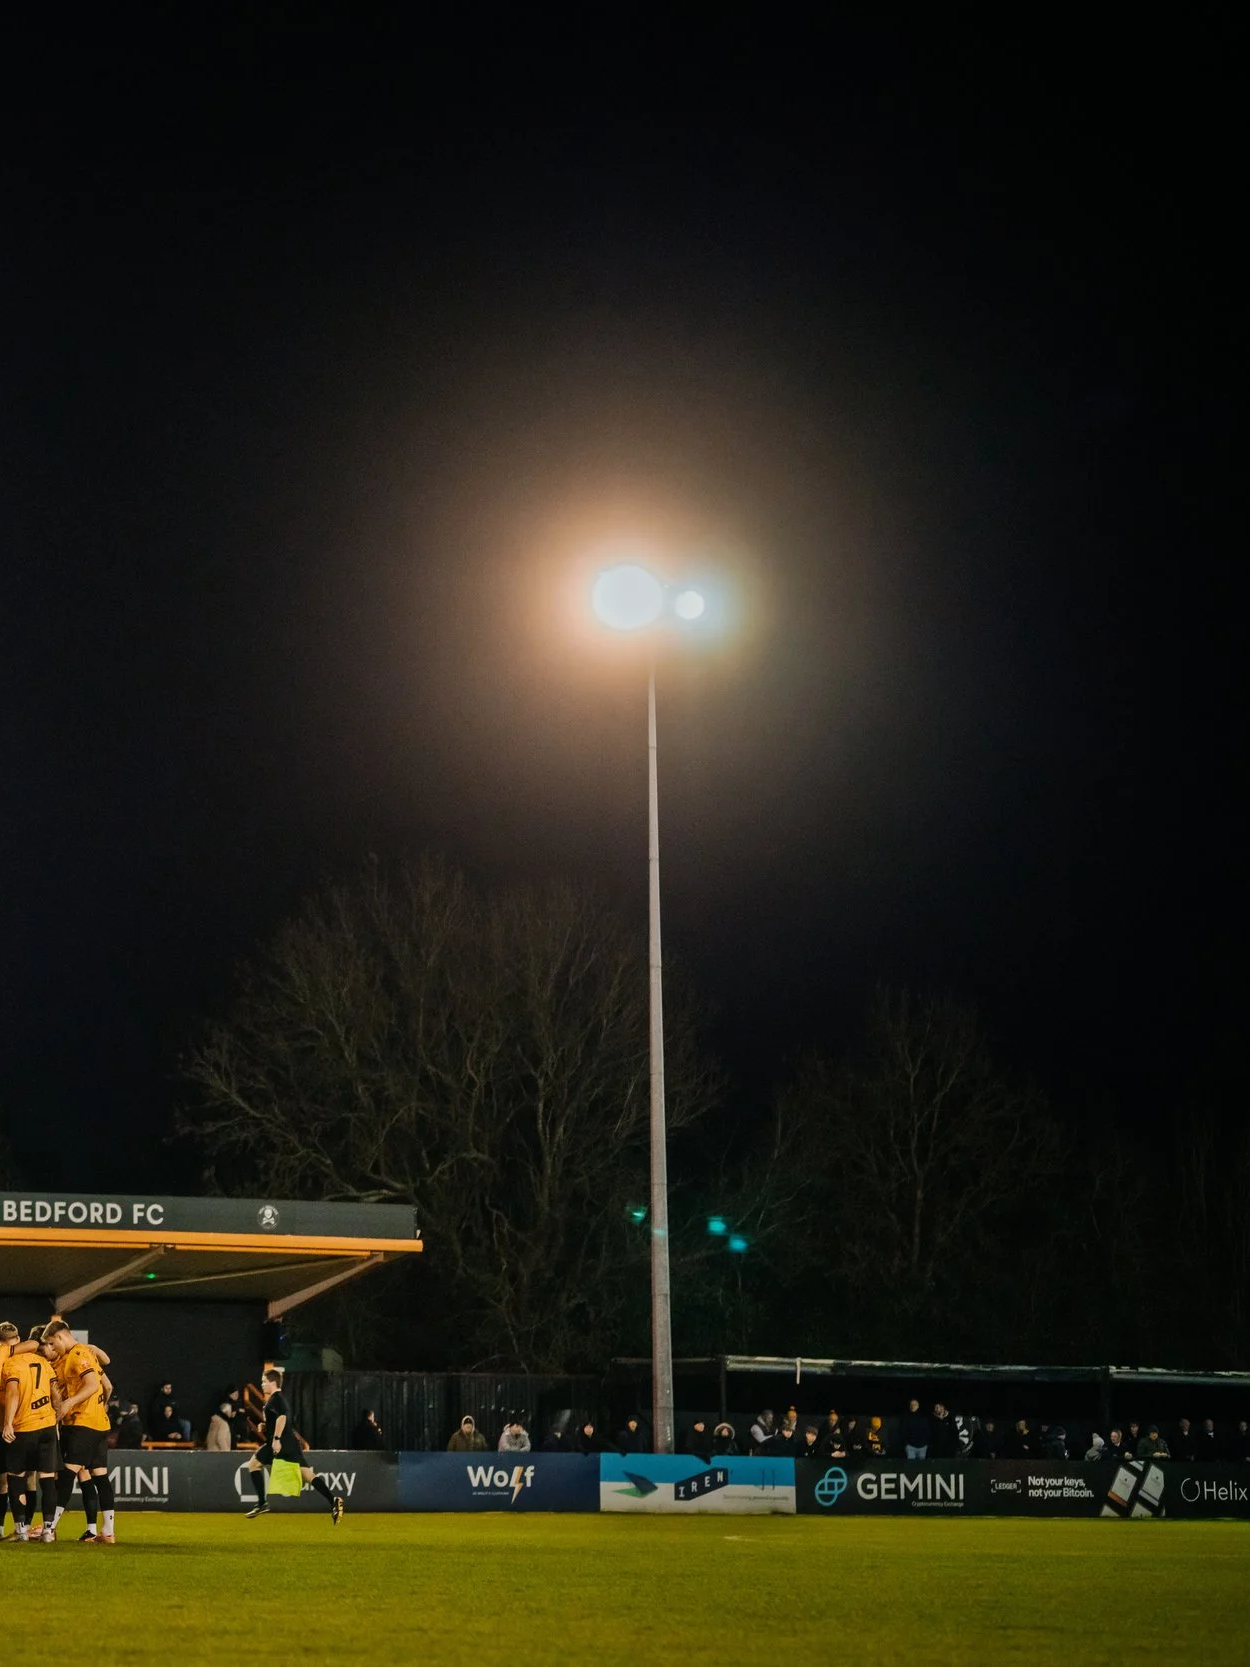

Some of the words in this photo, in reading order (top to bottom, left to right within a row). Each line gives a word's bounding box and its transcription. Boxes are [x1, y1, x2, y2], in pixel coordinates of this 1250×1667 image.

[3, 1200, 122, 1224] BEDFORD
[132, 1204, 164, 1225] FC
[29, 1363, 41, 1389] 7
[466, 1465, 535, 1503] Wolf
[678, 1471, 724, 1498] IREN
[856, 1473, 964, 1500] GEMINI
[1028, 1476, 1044, 1486] Not
[1044, 1478, 1064, 1488] your
[1064, 1477, 1086, 1488] keys,
[1029, 1488, 1044, 1497] not
[1043, 1490, 1063, 1499] your
[1063, 1488, 1095, 1498] Bitcoin.
[1203, 1480, 1249, 1501] Helix
